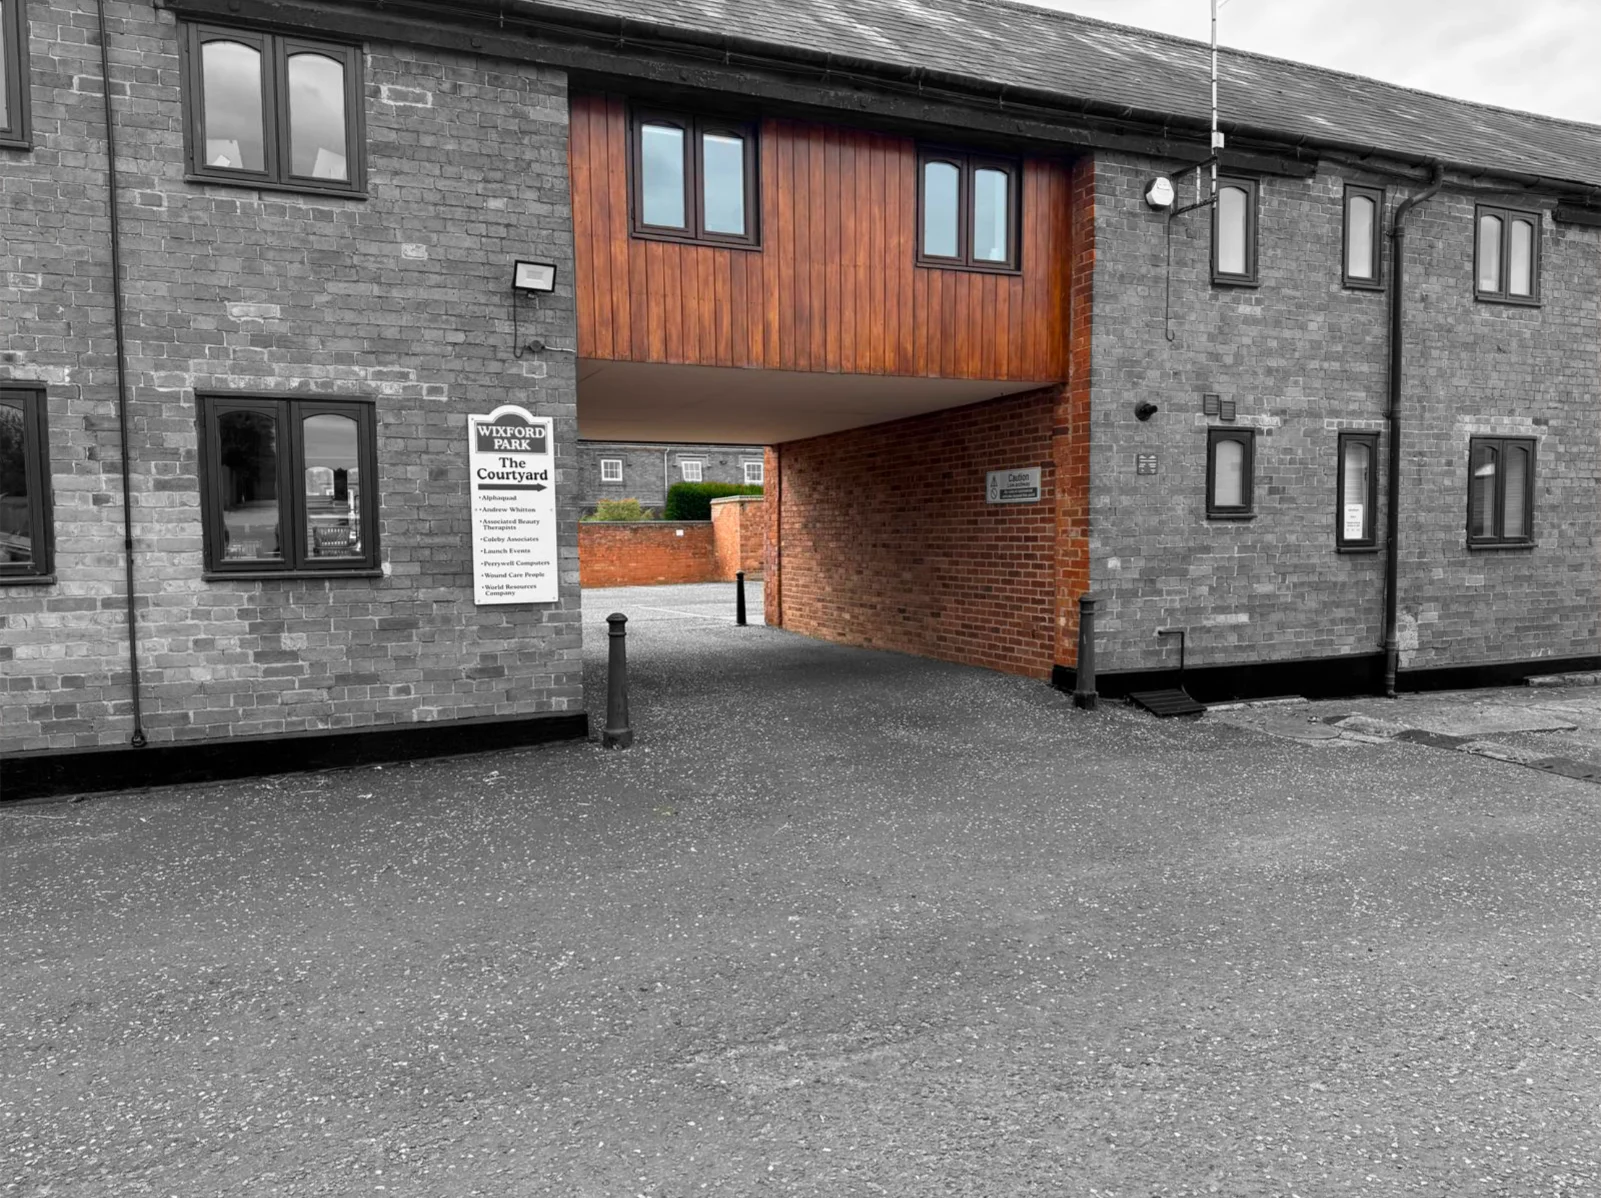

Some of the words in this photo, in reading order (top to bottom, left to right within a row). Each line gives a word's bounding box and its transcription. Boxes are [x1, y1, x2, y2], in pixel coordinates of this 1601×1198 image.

[477, 426, 546, 438] WIXFORD
[494, 438, 531, 450] PARK
[498, 457, 526, 468] The
[476, 467, 548, 483] Courtyard
[517, 518, 540, 526] Beauty
[524, 571, 545, 579] People
